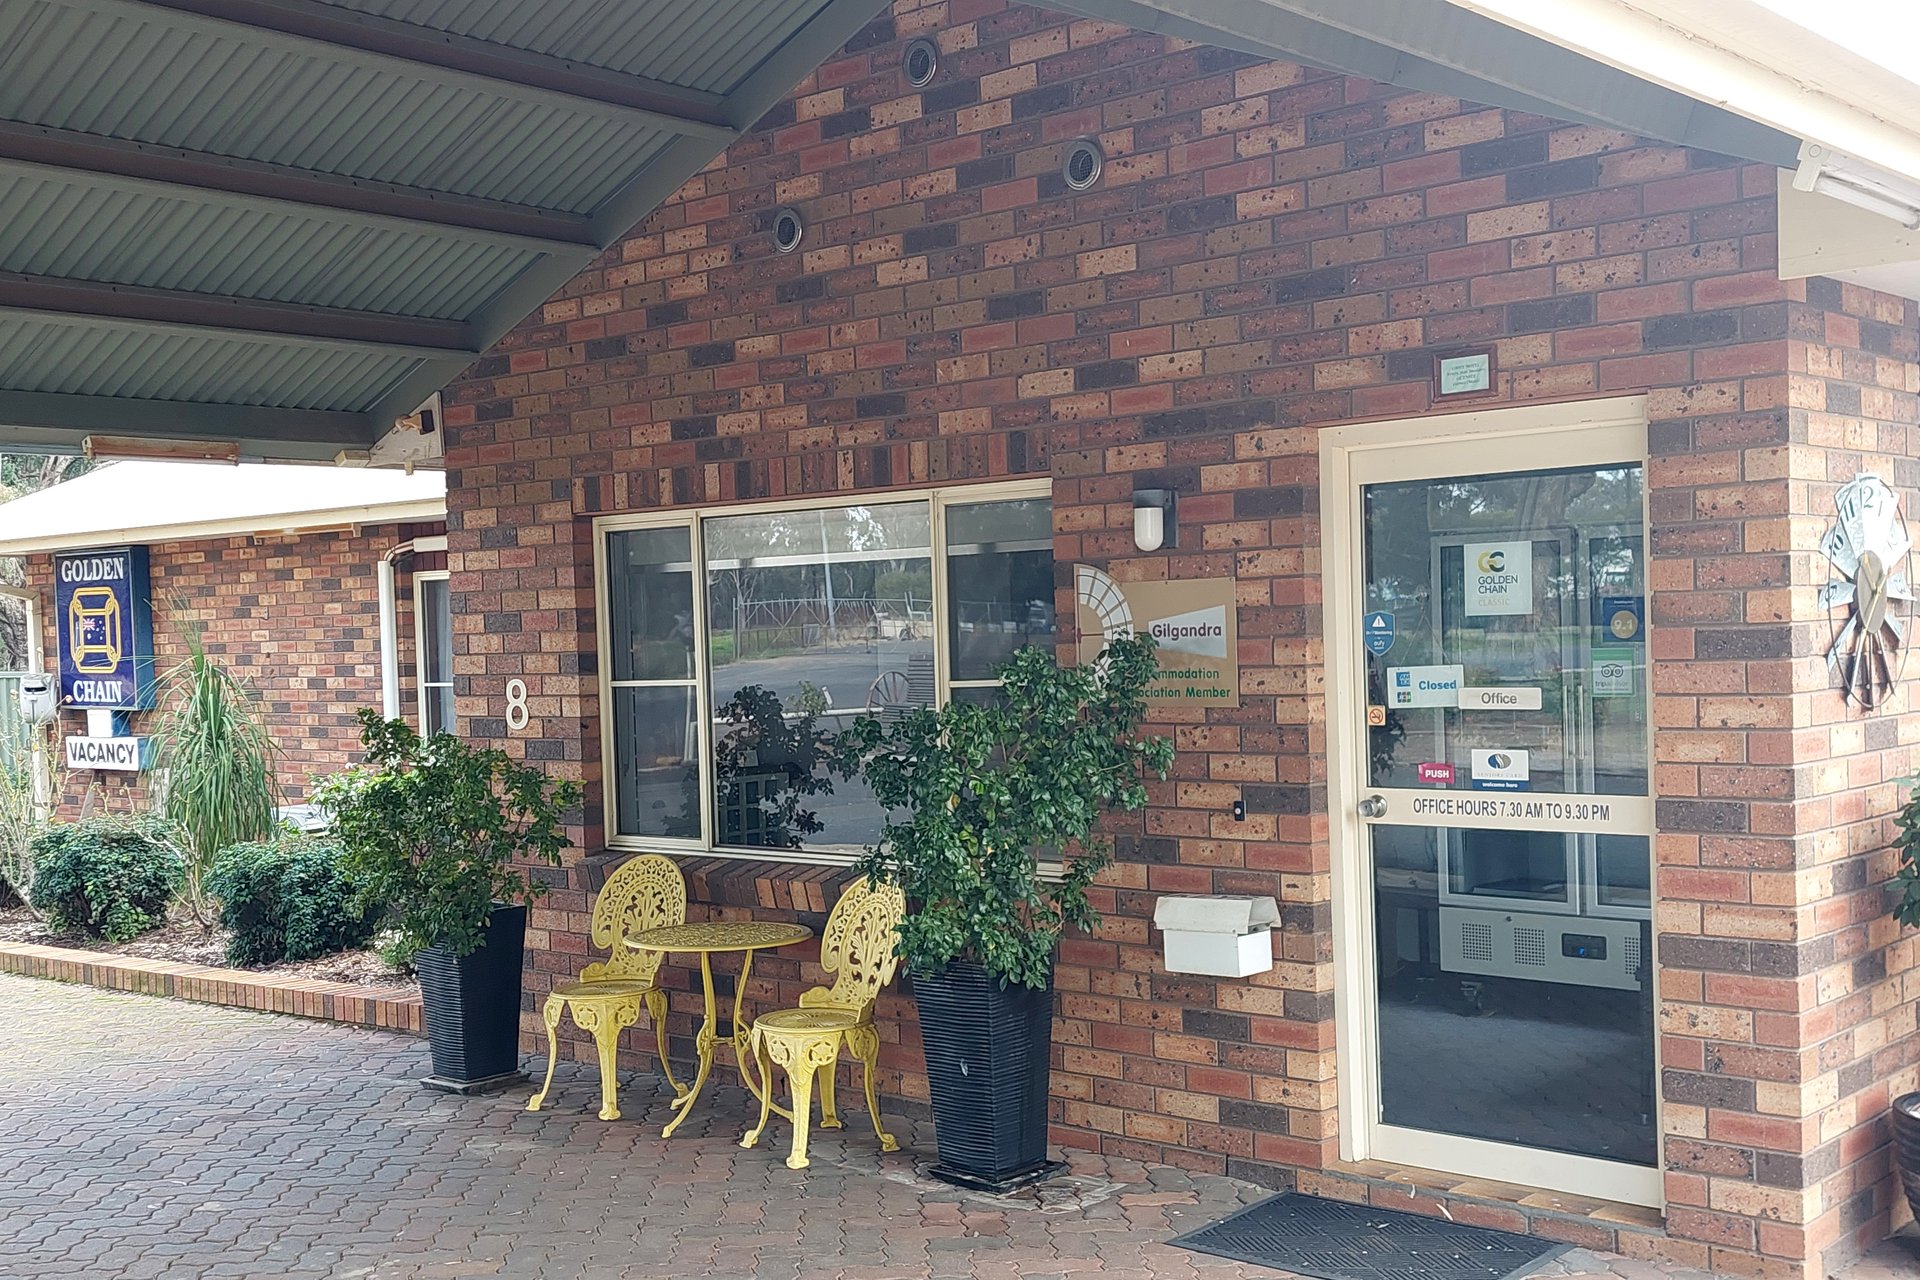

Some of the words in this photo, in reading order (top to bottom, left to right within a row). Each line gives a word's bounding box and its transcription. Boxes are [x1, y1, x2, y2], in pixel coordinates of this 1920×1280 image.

[61, 557, 124, 582] GOLDEN
[1478, 575, 1518, 585] GOLDEN
[1478, 585, 1507, 594] CHAIN
[1614, 619, 1633, 631] 9.1
[1152, 622, 1222, 641] Gilgandra
[1158, 667, 1219, 679] mmodation
[1419, 680, 1457, 690] Closed
[73, 680, 122, 703] CHAIN
[1140, 687, 1180, 698] ociation
[1186, 686, 1231, 698] Member
[1481, 692, 1518, 704] Office
[506, 679, 529, 730] 8
[68, 742, 135, 764] VACANCY
[1425, 769, 1450, 779] PUSH
[1413, 798, 1454, 815] OFFICE
[1456, 800, 1498, 816] HOURS
[1500, 801, 1522, 817] 7.30
[1525, 803, 1544, 818] AM
[1546, 803, 1563, 819] TO
[1565, 804, 1589, 820] 9.30
[1591, 805, 1610, 820] PM
